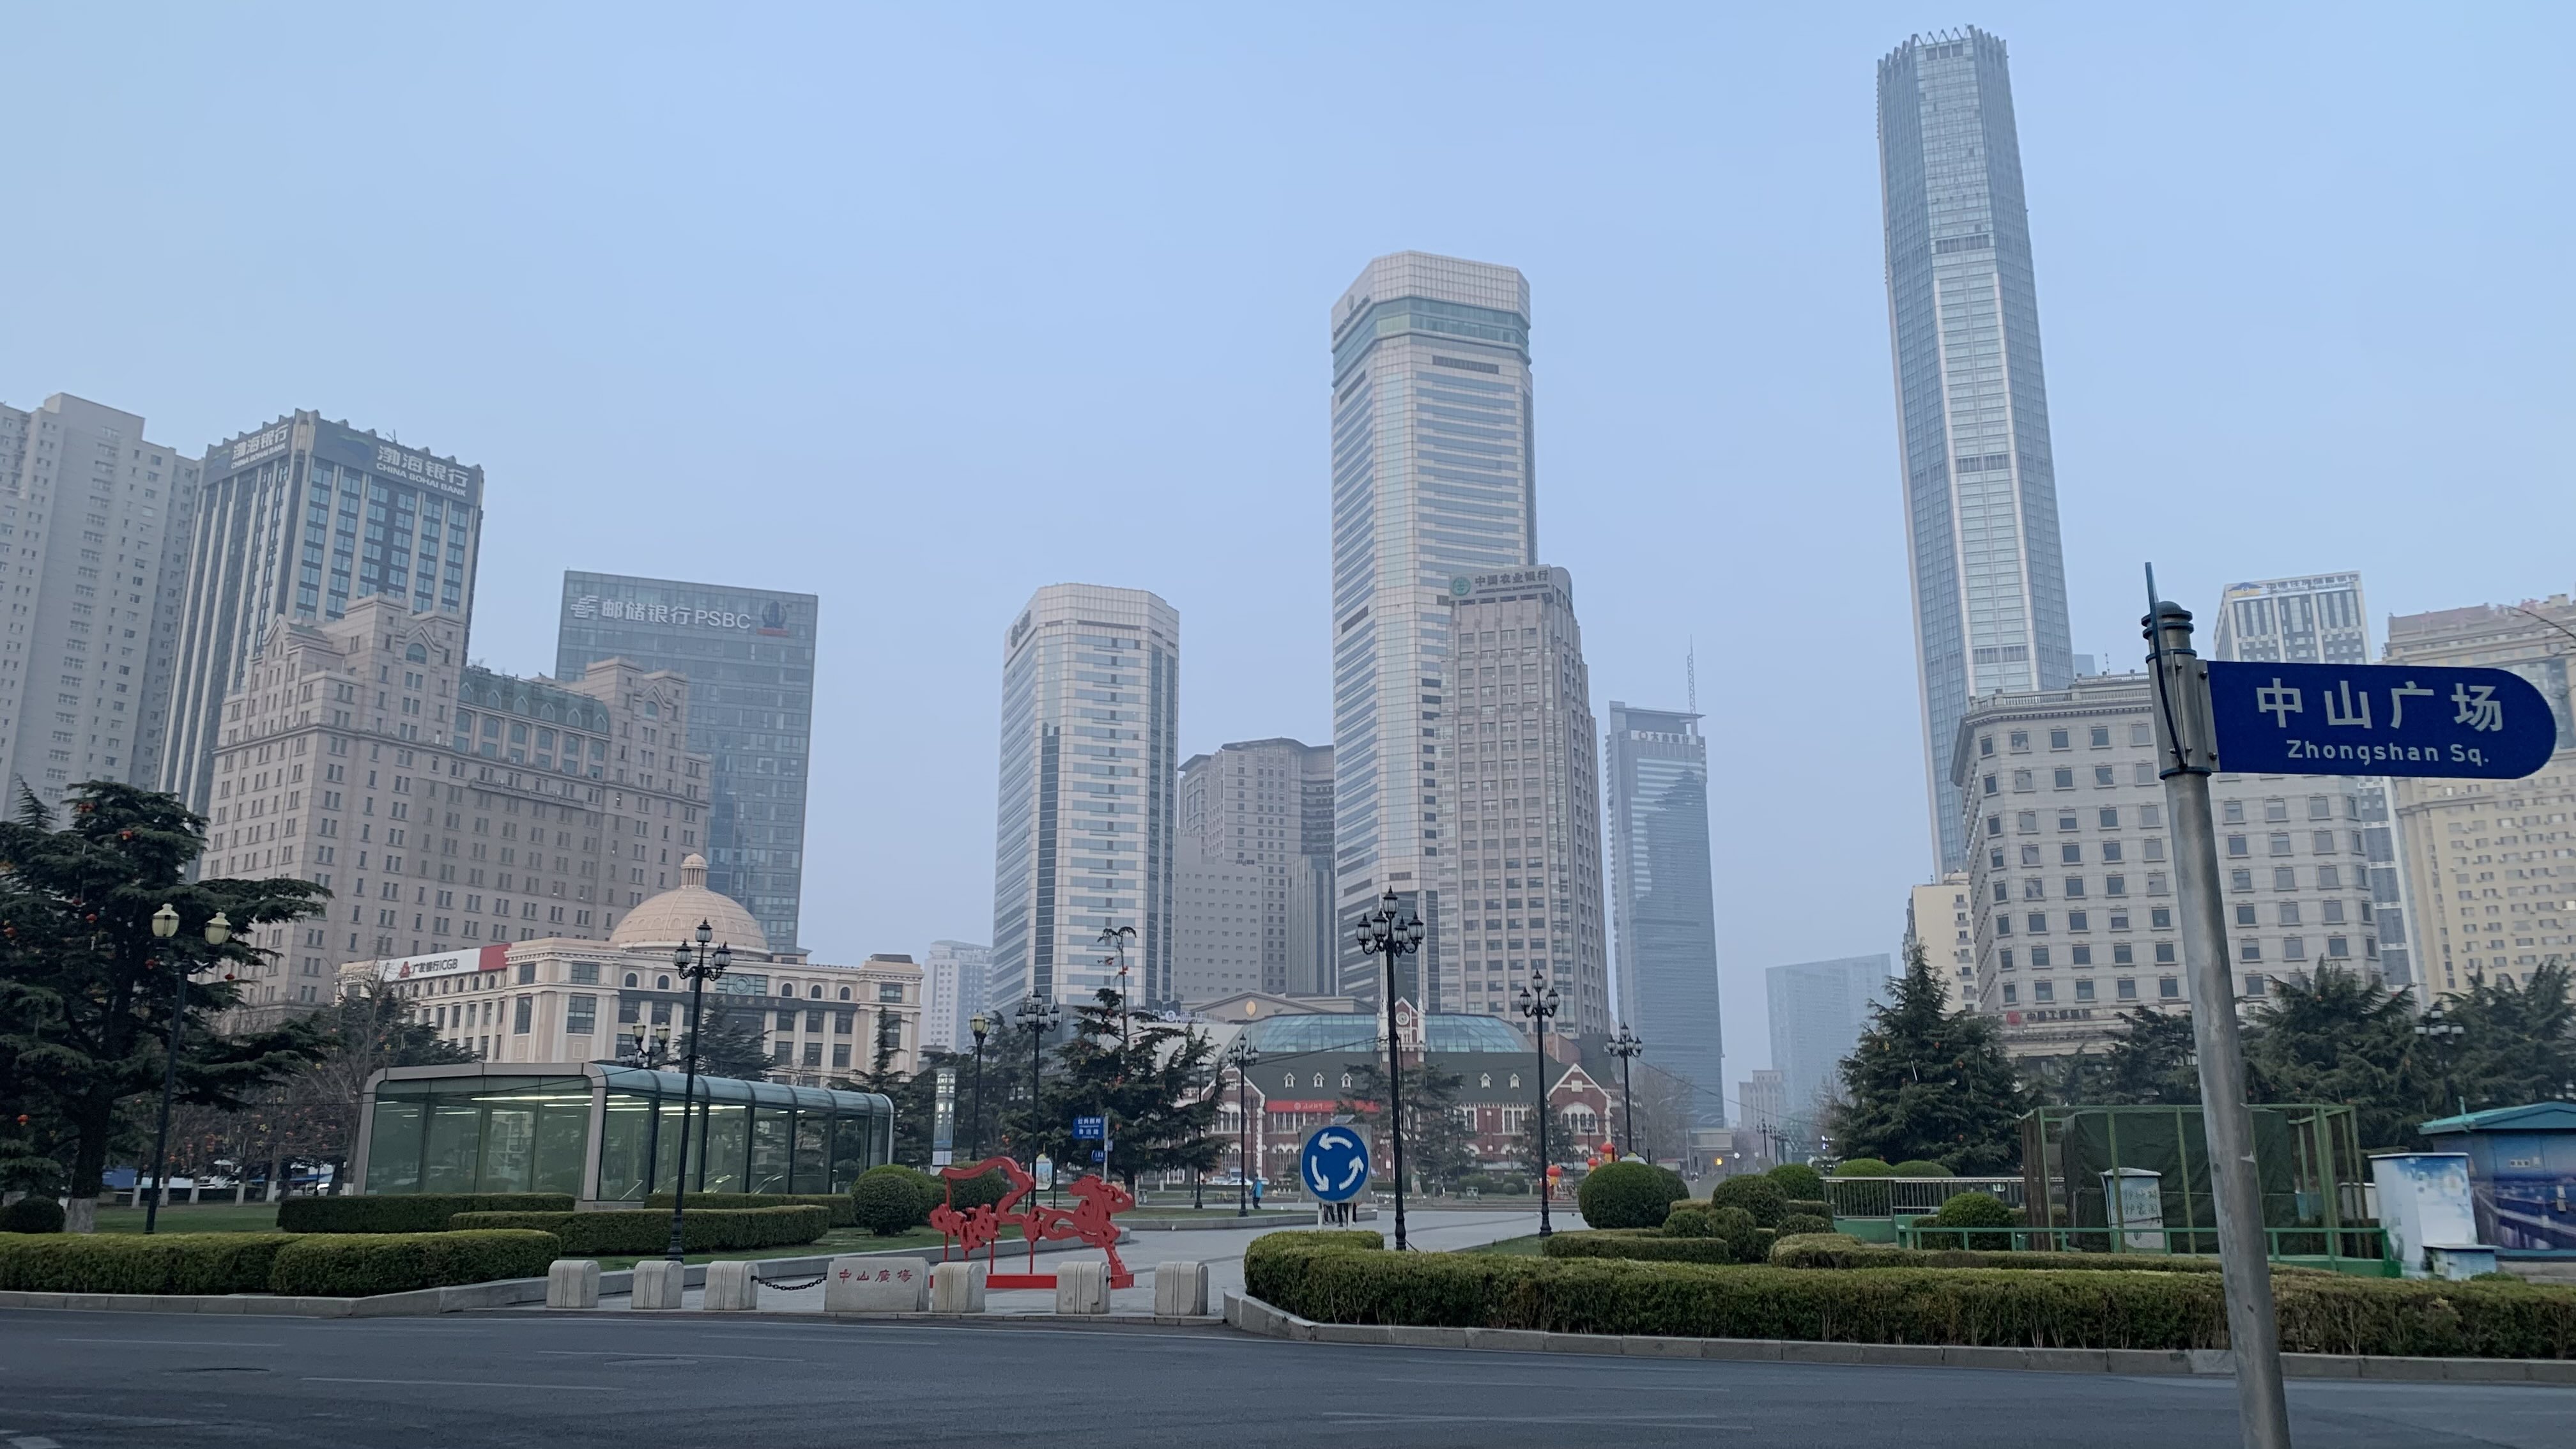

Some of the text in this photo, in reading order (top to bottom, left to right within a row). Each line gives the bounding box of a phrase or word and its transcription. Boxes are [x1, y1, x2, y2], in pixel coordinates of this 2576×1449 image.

[232, 424, 288, 460] 渤海银行
[376, 463, 466, 497] CHINA BOHAI BANK
[377, 445, 468, 487] 渤海银行
[1475, 570, 1549, 586] 中国农业银行
[602, 599, 751, 629] 邮储银行 PSBC
[2256, 677, 2503, 732] 中山广场
[2286, 739, 2489, 767] Zhongshan Sq.
[411, 958, 458, 974] 广发银行 CGB
